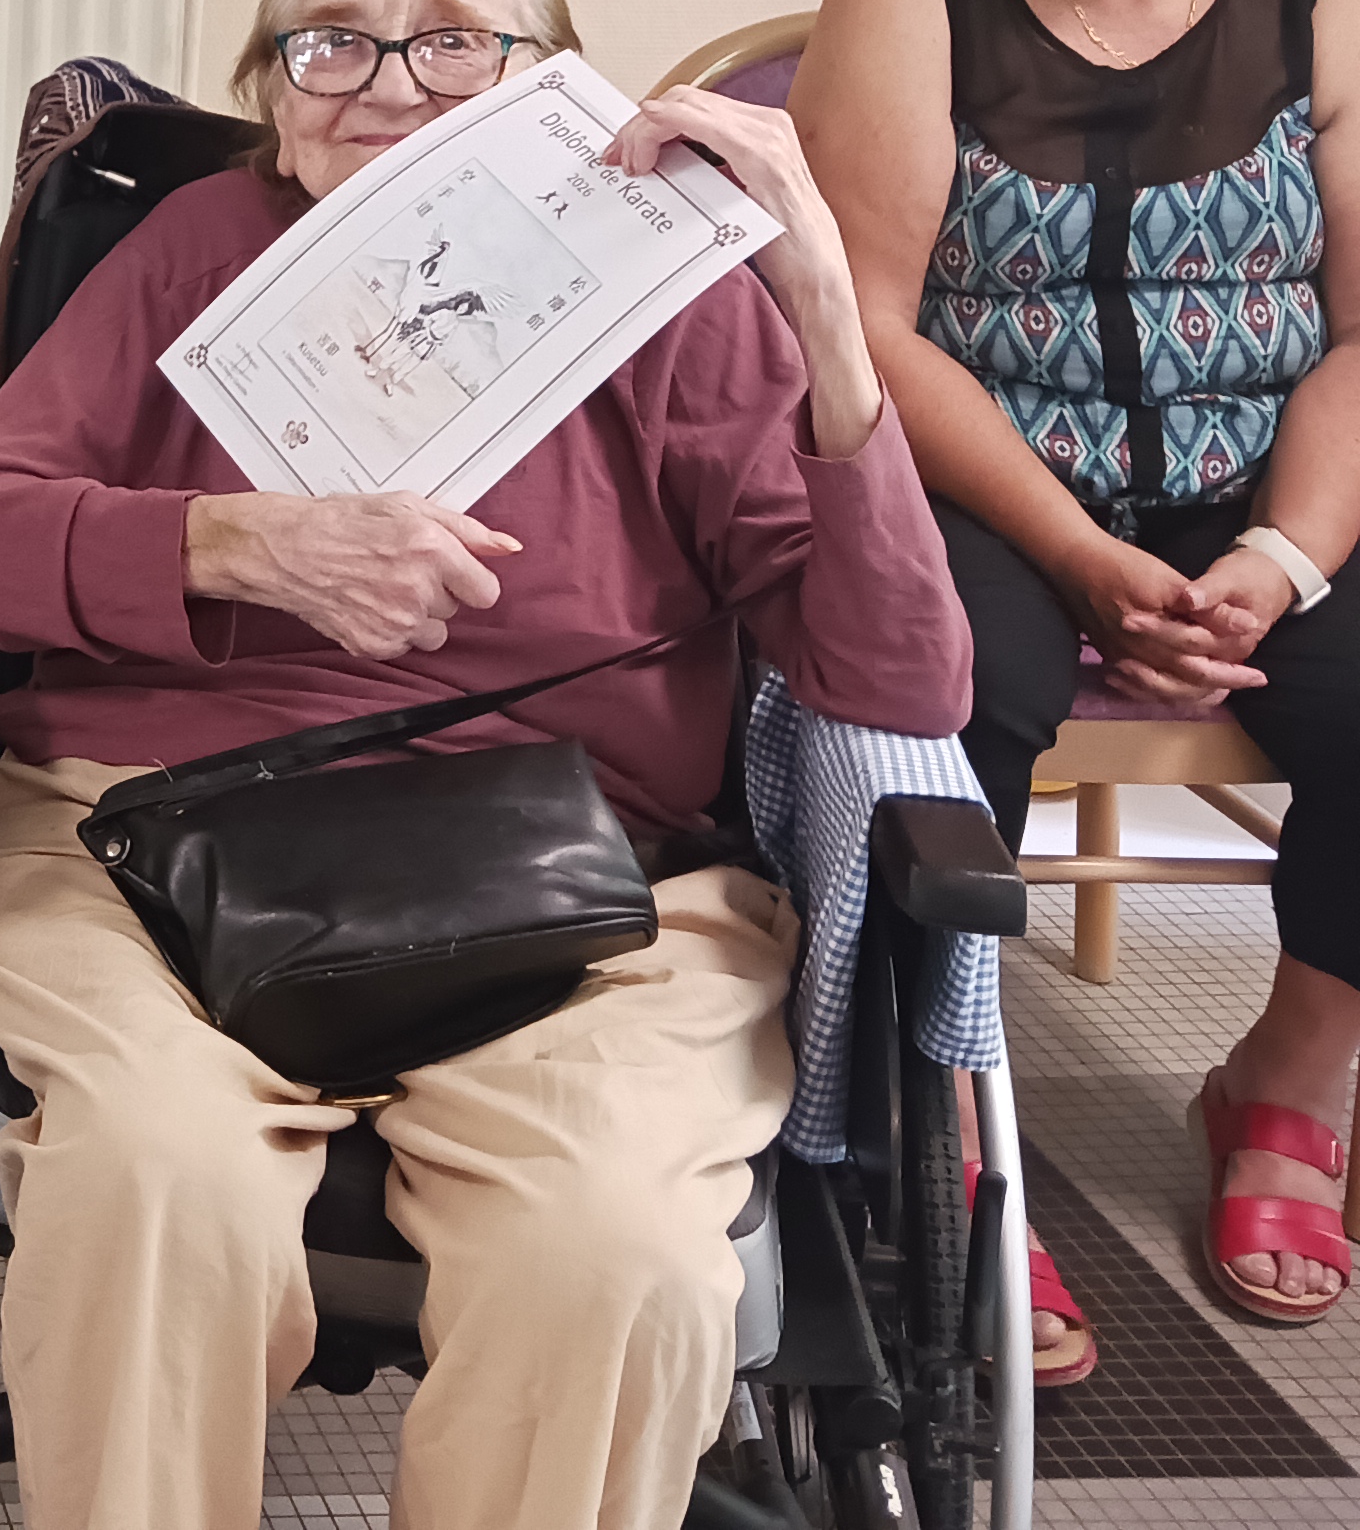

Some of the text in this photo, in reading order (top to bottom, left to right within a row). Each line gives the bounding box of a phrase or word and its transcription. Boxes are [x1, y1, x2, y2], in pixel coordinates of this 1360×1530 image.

[539, 112, 674, 234] Diplôme de Karate
[566, 172, 596, 198] 2026
[297, 341, 329, 377] Kusetsu
